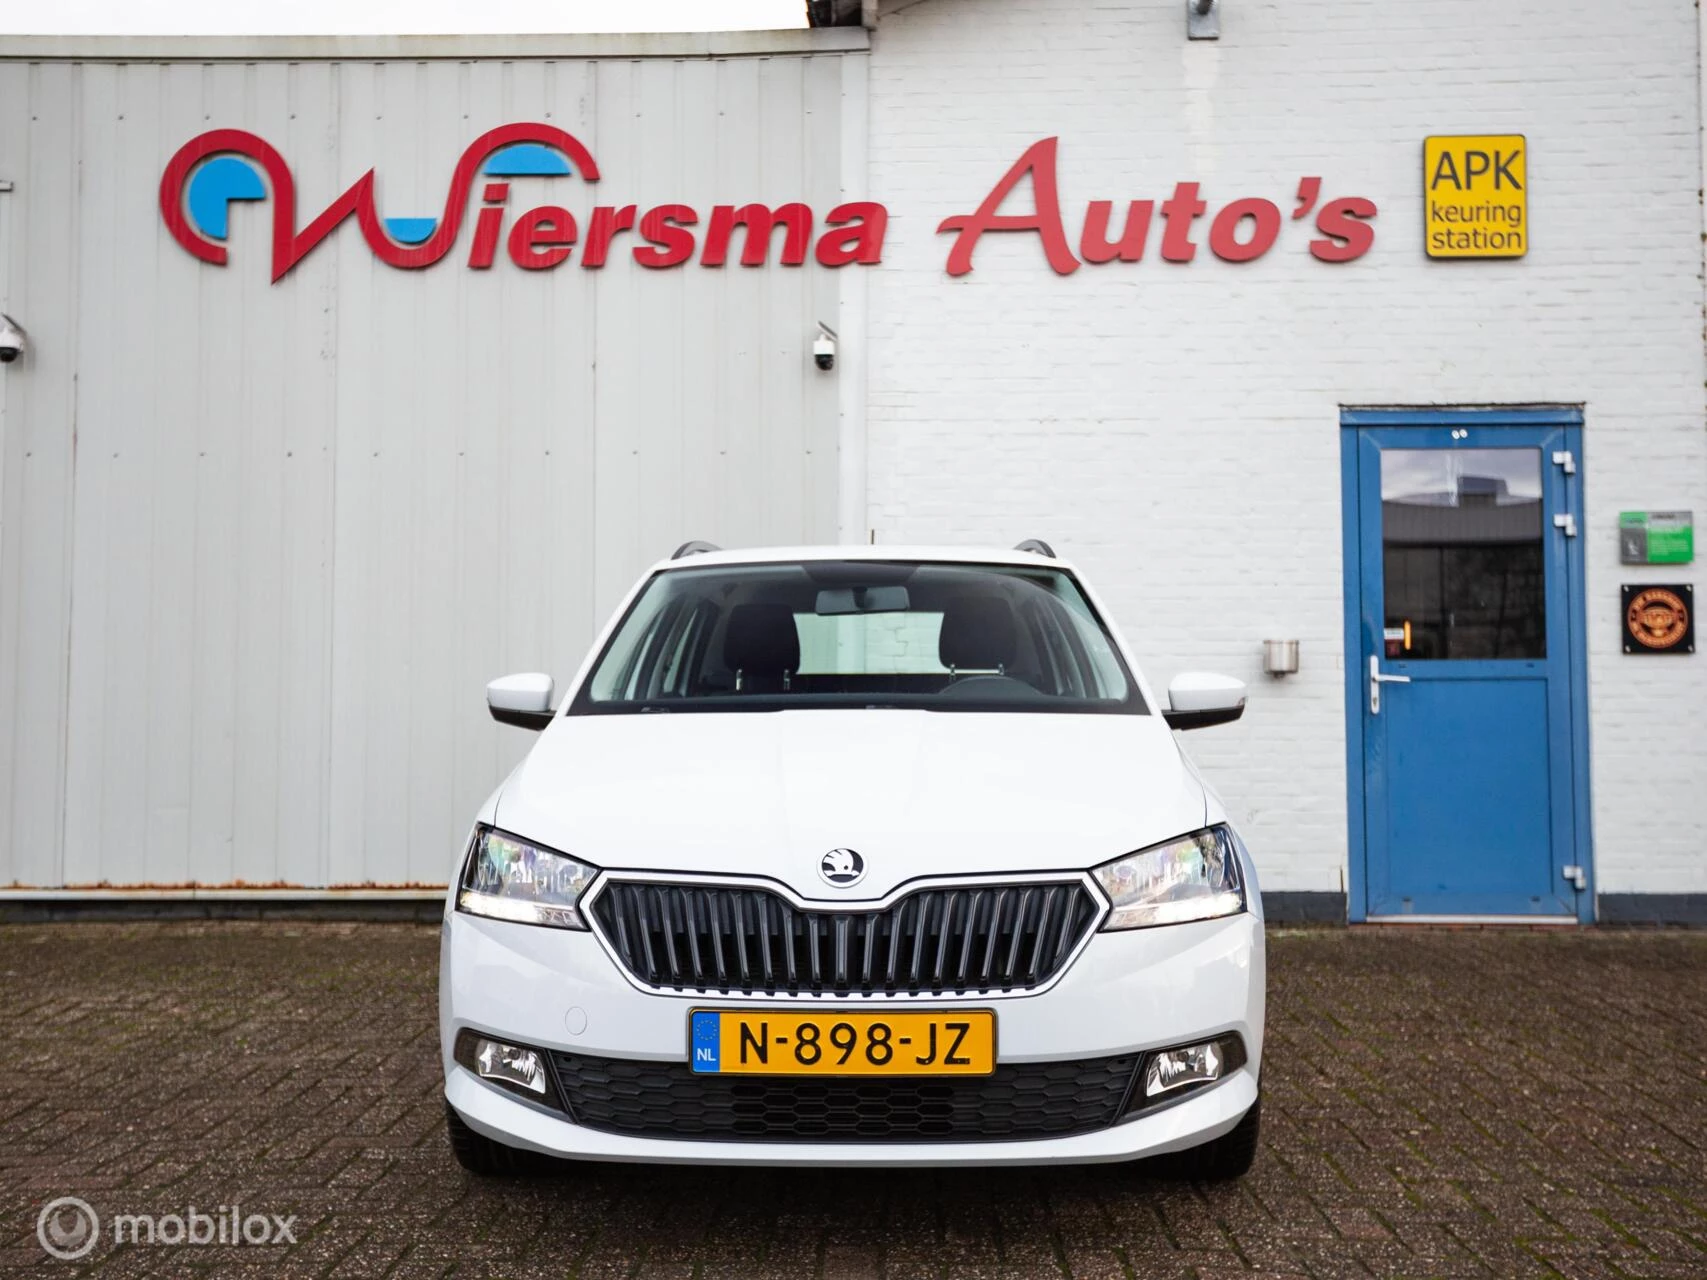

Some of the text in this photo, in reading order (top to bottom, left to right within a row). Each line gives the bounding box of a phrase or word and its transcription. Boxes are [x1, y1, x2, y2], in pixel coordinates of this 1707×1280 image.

[1431, 149, 1523, 191] APK
[159, 121, 1377, 285] Wiersma Auto's
[1431, 200, 1522, 229] keuring
[1431, 227, 1523, 249] station
[696, 1021, 971, 1066] NL N-898-JZ
